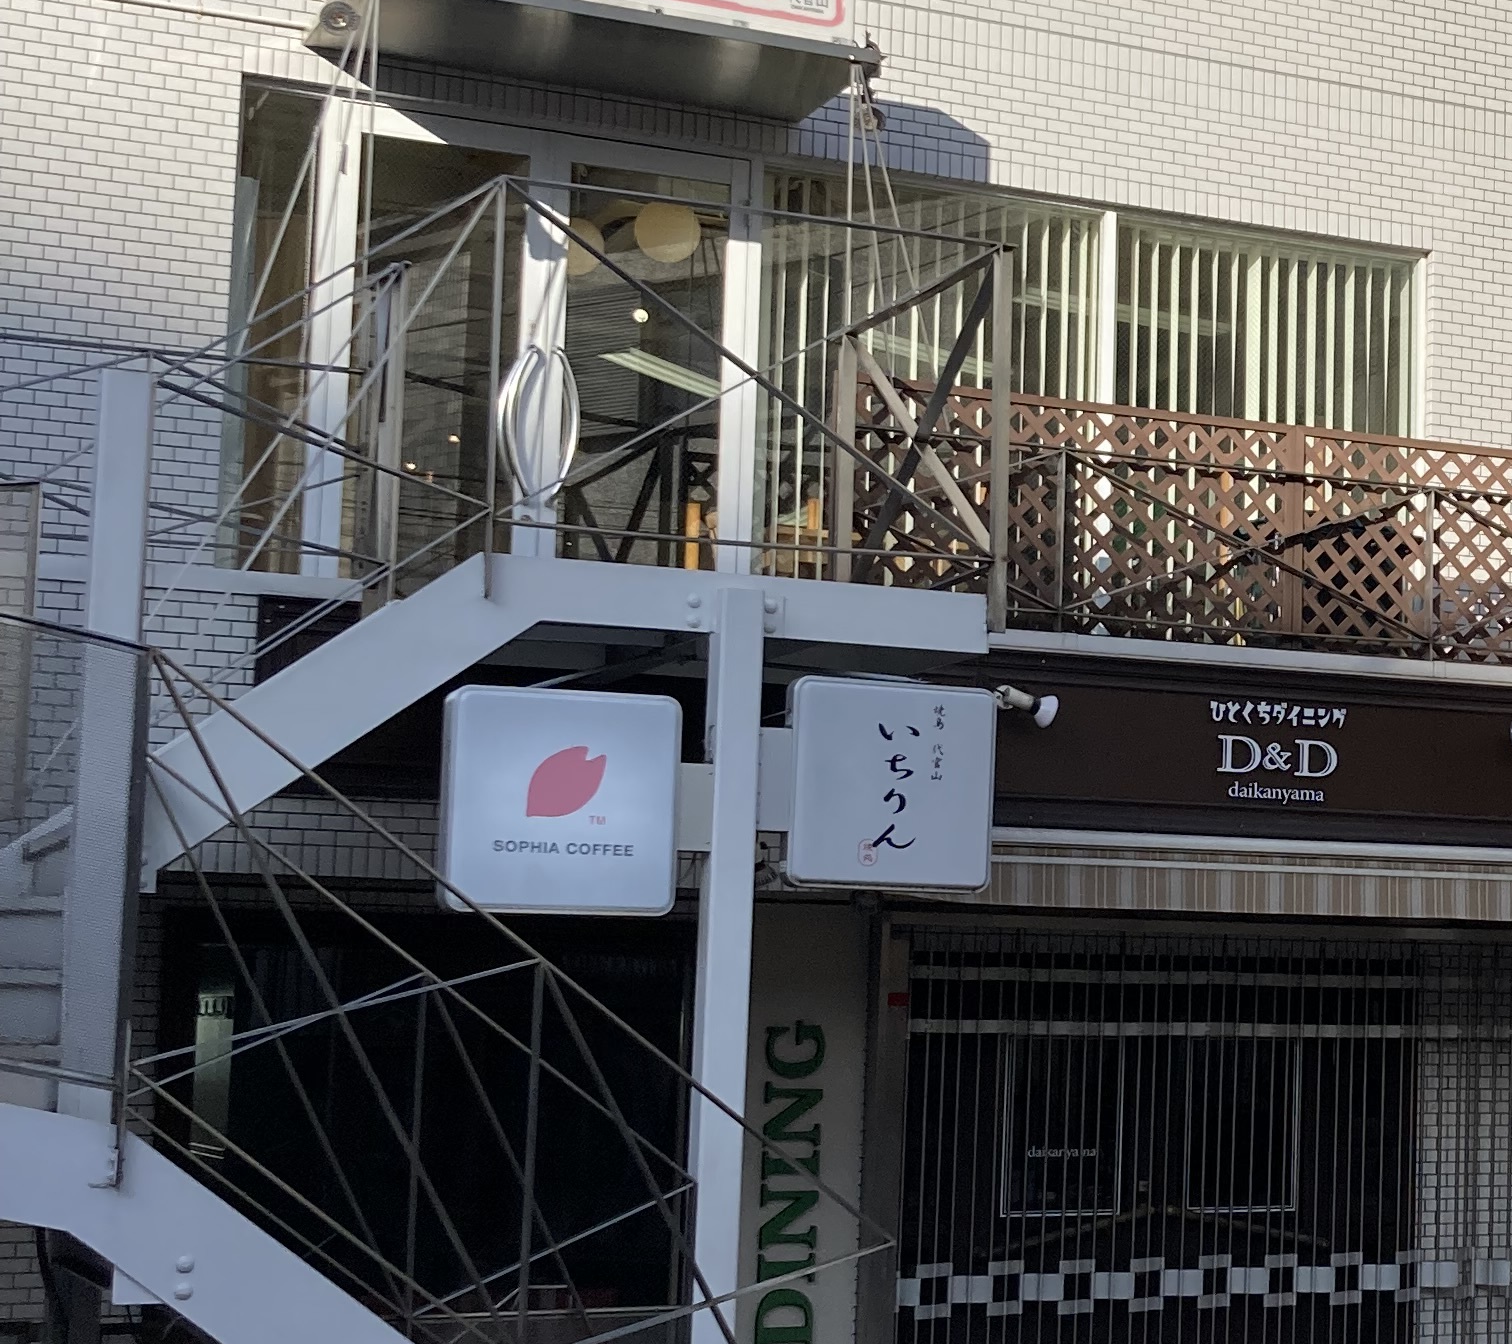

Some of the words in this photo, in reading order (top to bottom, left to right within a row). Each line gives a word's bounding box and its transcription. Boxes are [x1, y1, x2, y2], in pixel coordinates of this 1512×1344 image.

[1210, 700, 1347, 729] ひとくちダイニング
[1216, 734, 1338, 778] D&D
[872, 722, 920, 849] いちりん
[1228, 781, 1325, 805] daikanyama
[492, 839, 560, 855] SOPHIA
[565, 842, 635, 857] COFFEE
